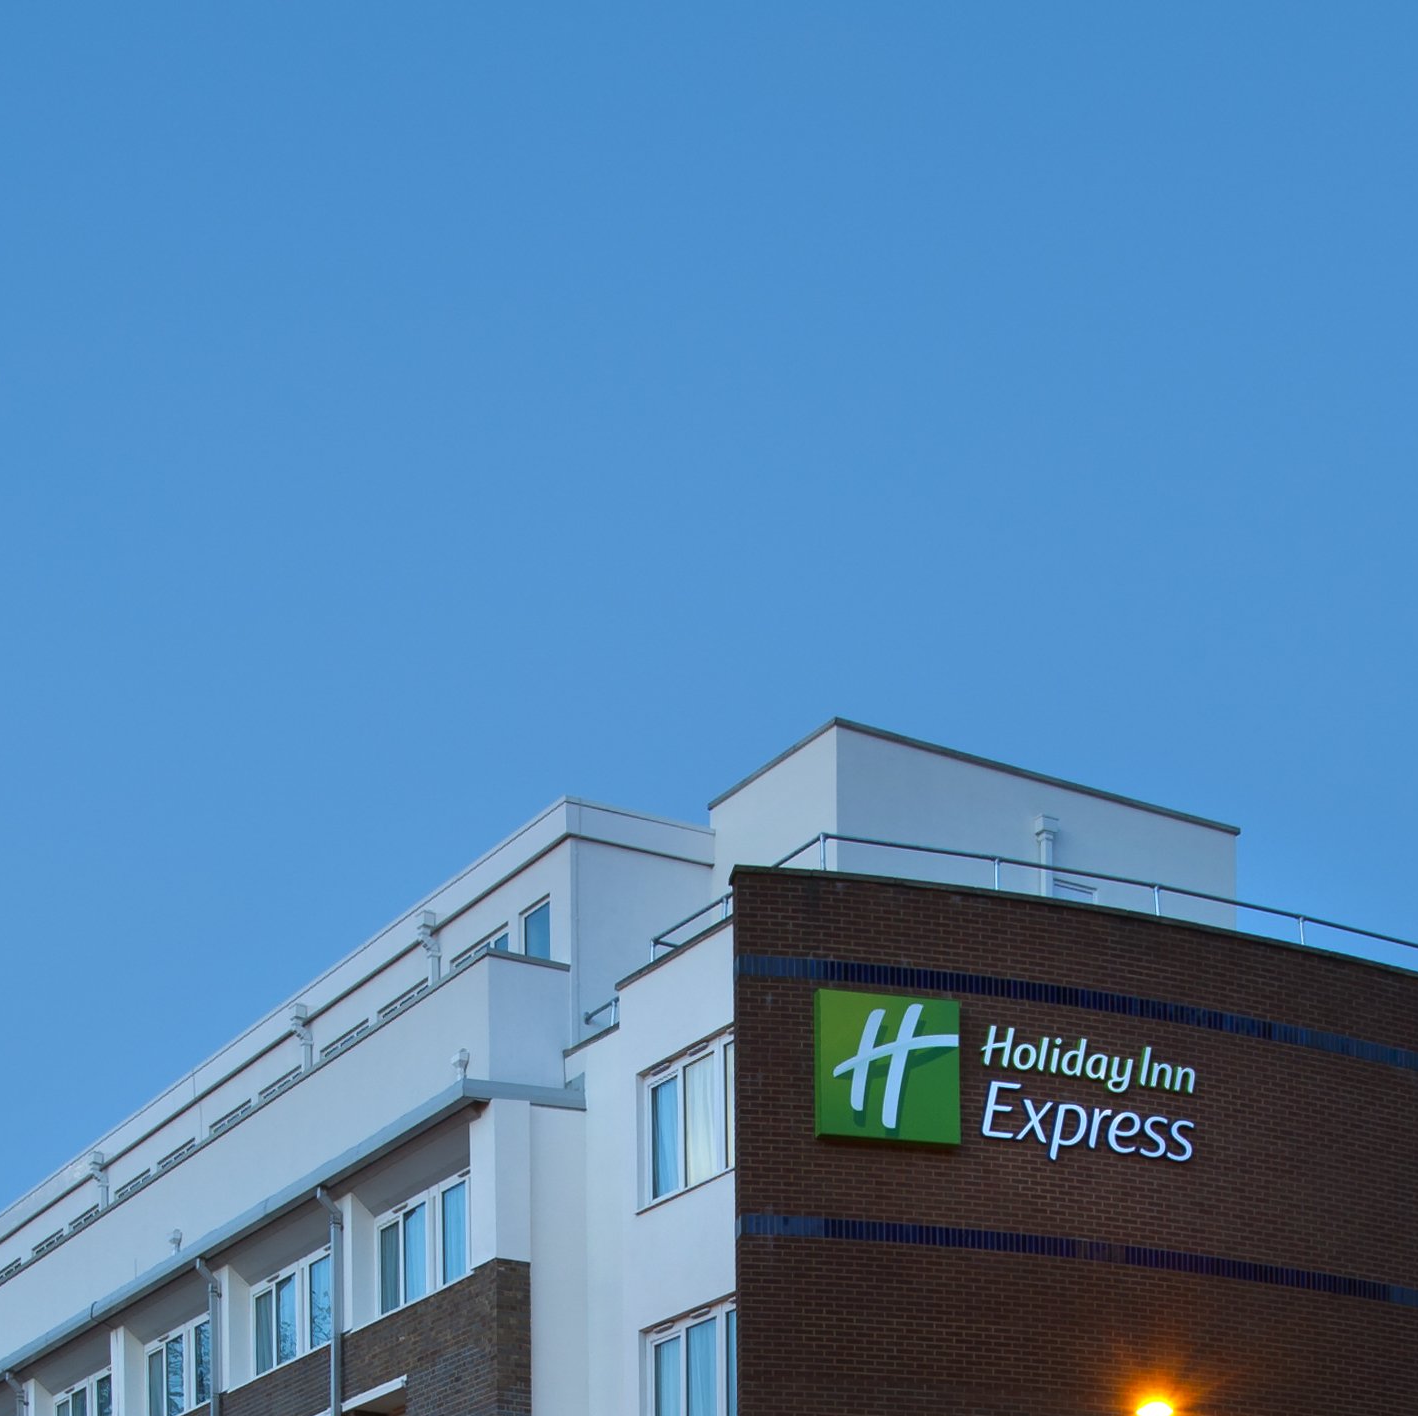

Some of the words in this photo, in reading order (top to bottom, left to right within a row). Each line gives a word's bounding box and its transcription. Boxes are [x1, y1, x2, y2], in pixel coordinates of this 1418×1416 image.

[981, 1025, 1134, 1093] Holiday
[1139, 1047, 1196, 1094] Inn
[981, 1081, 1195, 1161] Express
